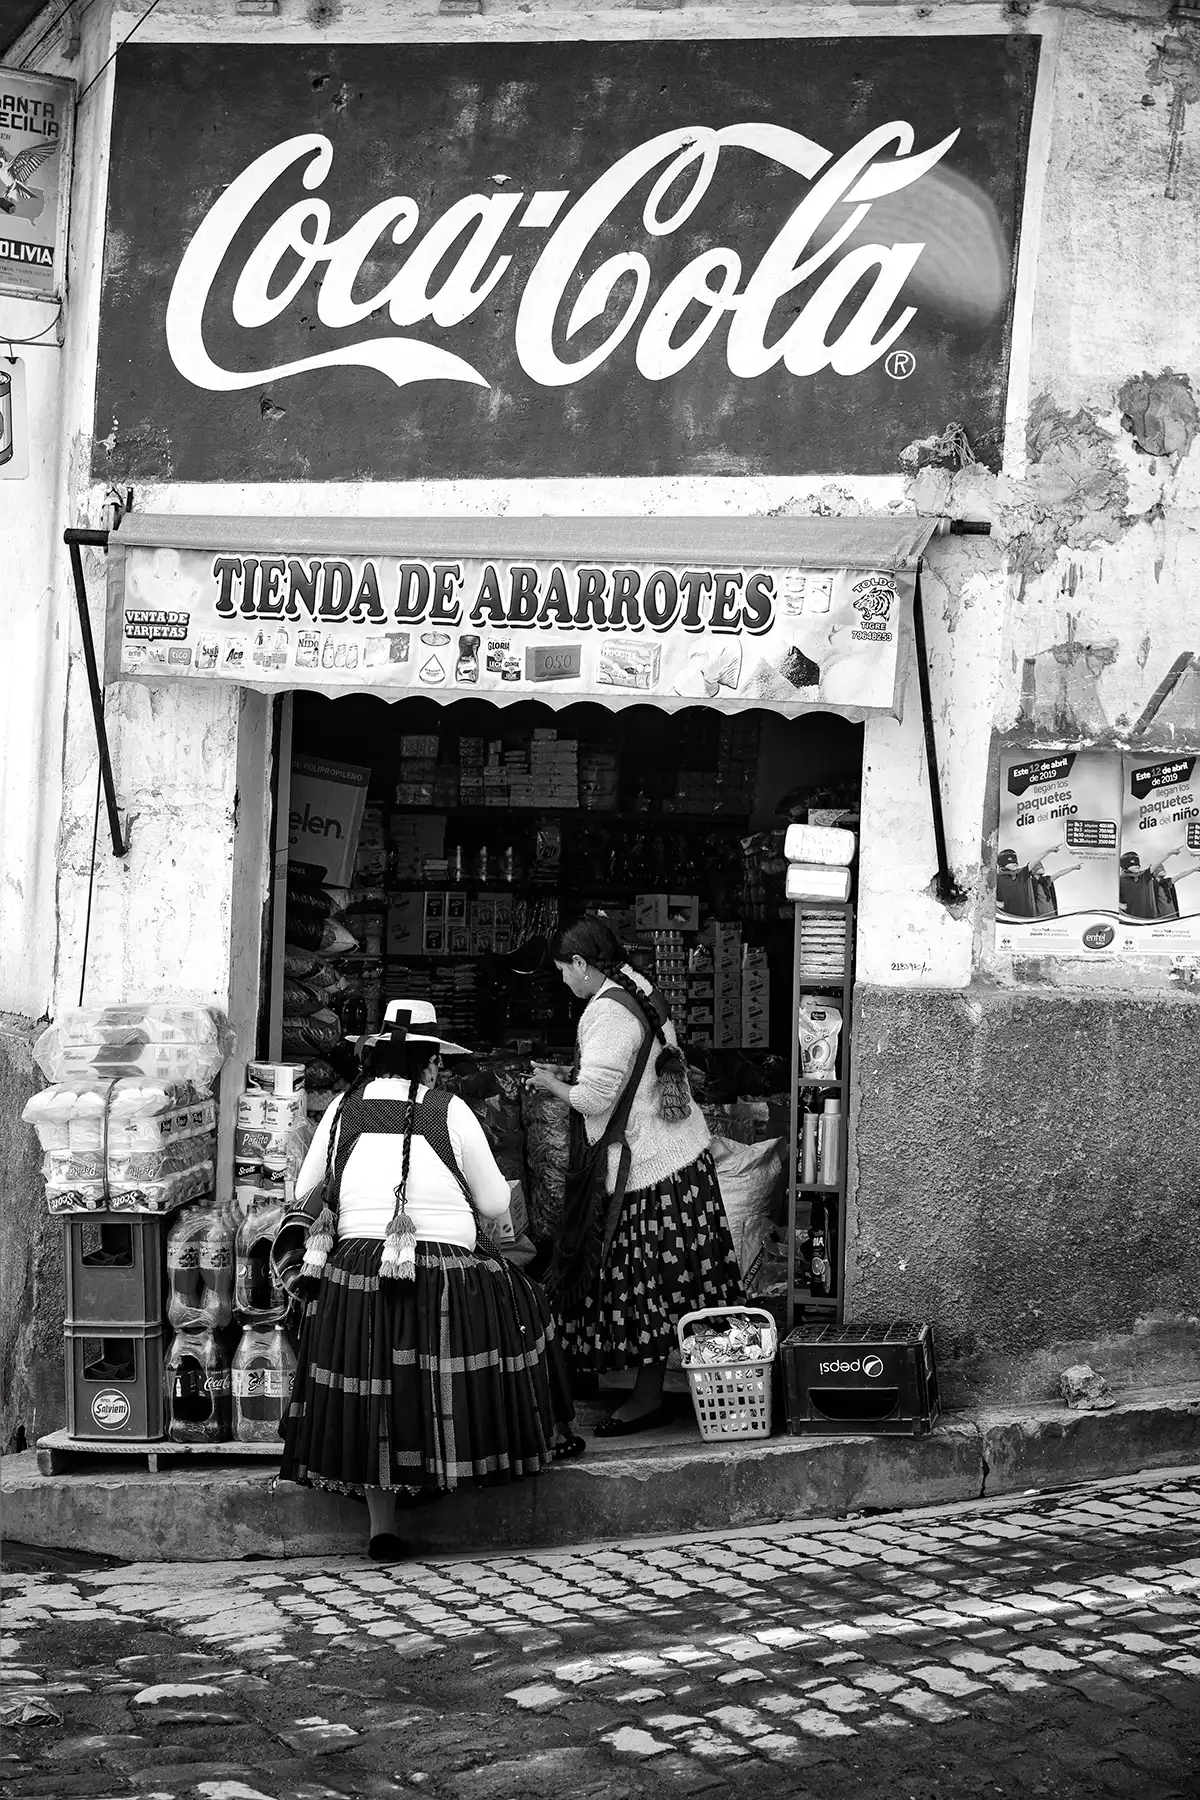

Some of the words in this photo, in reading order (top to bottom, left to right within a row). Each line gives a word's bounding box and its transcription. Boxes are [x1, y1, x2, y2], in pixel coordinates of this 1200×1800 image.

[0, 94, 54, 119] ANTA
[166, 120, 960, 391] Coca-Cola
[213, 557, 387, 622] TIENDA
[395, 562, 464, 625] DE
[469, 565, 776, 634] ABARROTES
[125, 609, 166, 624] VENTA
[167, 611, 190, 625] DE
[860, 621, 887, 630] TIGRE
[125, 624, 187, 640] TARJETAS
[851, 630, 893, 642] 79648253
[298, 639, 319, 648] NIDO
[488, 641, 510, 651] GLORIA
[544, 653, 572, 669] OSO
[303, 762, 363, 782] POLIPROPILENO
[1013, 768, 1029, 777] Este
[1029, 763, 1040, 773] 12
[1041, 763, 1050, 771] de
[1051, 758, 1068, 768] abril
[1029, 774, 1039, 782] de
[1040, 769, 1057, 780] 2019
[1136, 772, 1151, 781] Este
[1151, 767, 1161, 777] 12
[1162, 766, 1171, 774] de
[1172, 761, 1188, 772] abril
[1034, 782, 1056, 794] llegan
[1057, 780, 1069, 789] los
[1151, 778, 1161, 786] de
[1161, 773, 1178, 784] 2019
[1156, 786, 1178, 798] llegan
[1179, 783, 1190, 791] los
[1017, 790, 1072, 814] paquetes
[1140, 794, 1194, 818] paquetes
[1016, 813, 1035, 827] día
[1037, 812, 1048, 822] del
[1050, 803, 1078, 819] niño
[1138, 816, 1157, 830] día
[1159, 815, 1171, 825] del
[1172, 806, 1200, 822] niño
[51, 1192, 75, 1210] Scott
[113, 1191, 138, 1208] Scott
[819, 1358, 861, 1375] pepsi
